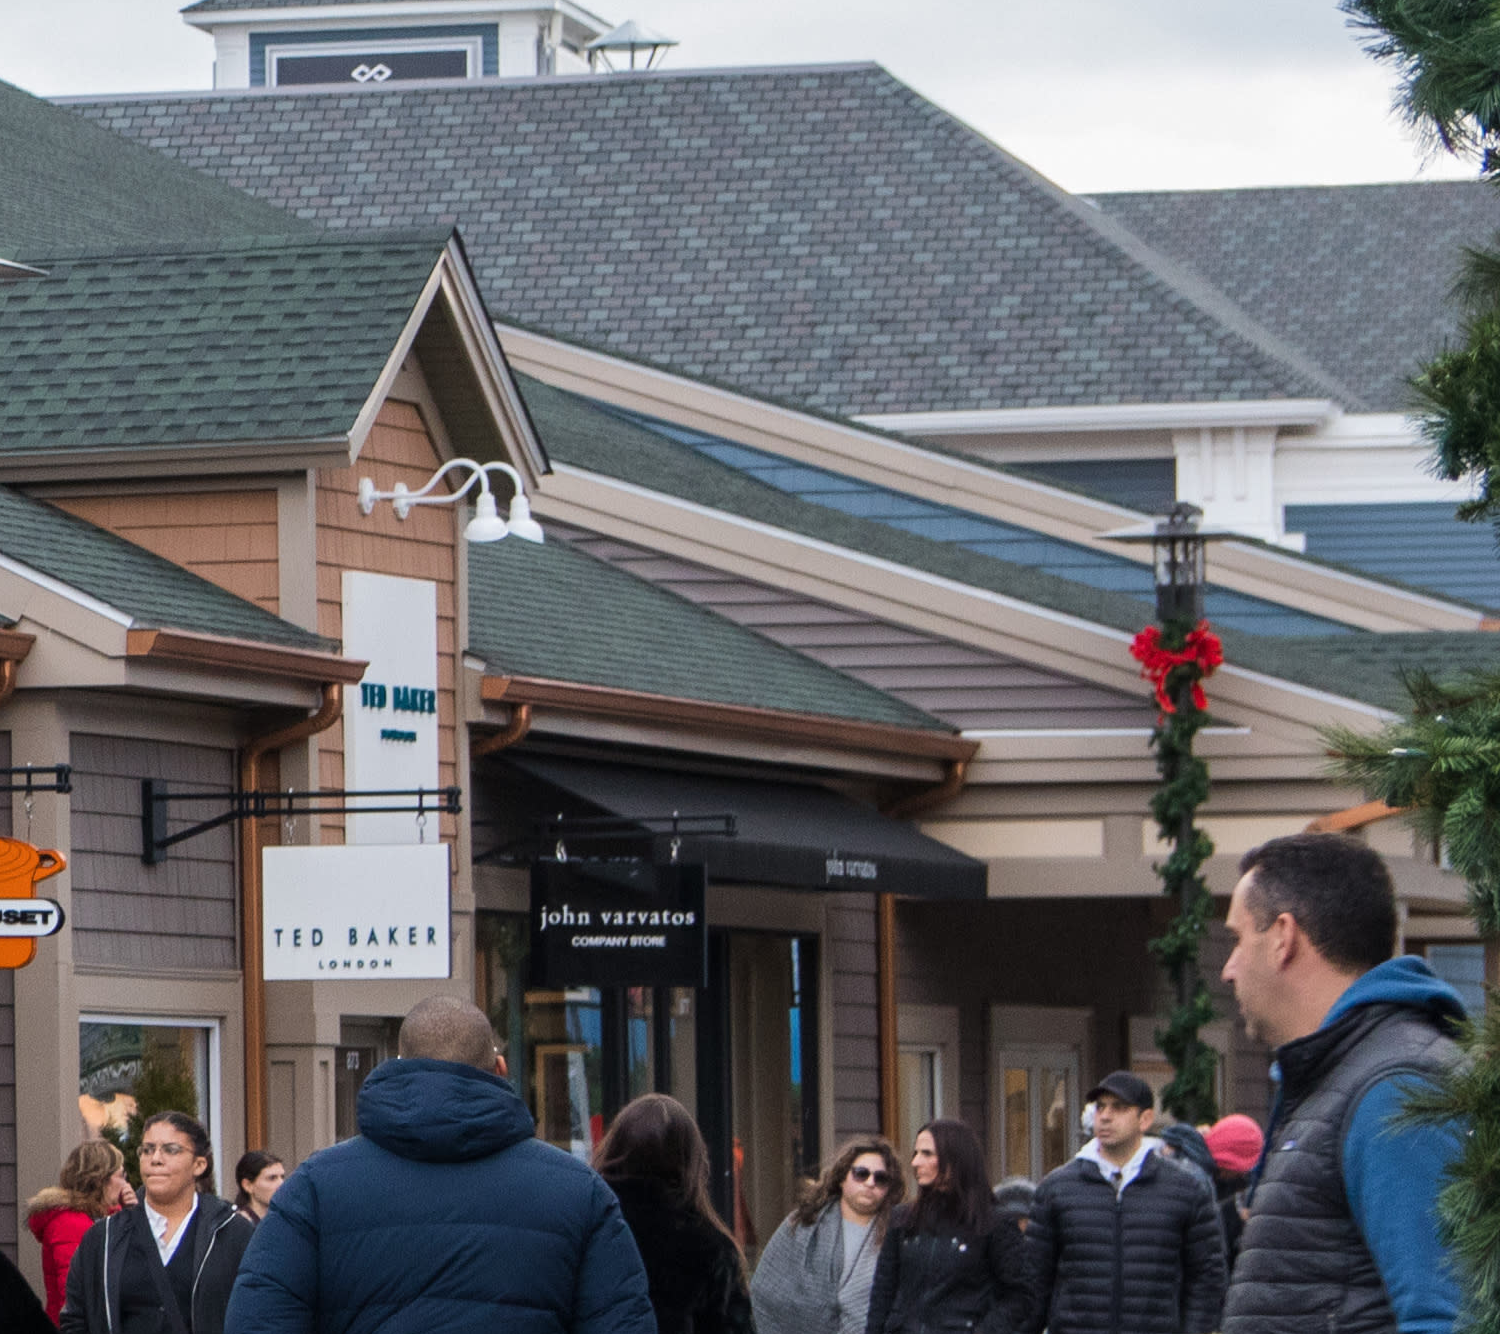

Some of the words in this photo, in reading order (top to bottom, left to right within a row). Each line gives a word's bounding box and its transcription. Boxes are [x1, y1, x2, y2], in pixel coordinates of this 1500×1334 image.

[361, 682, 387, 709] TED
[392, 686, 436, 715] BAKER
[540, 903, 591, 931] john
[601, 909, 695, 926] varvatos
[274, 927, 324, 947] TED
[348, 926, 437, 946] BAKER
[571, 935, 628, 948] COMPANY
[630, 934, 667, 947] STORE
[318, 959, 393, 970] LONDON
